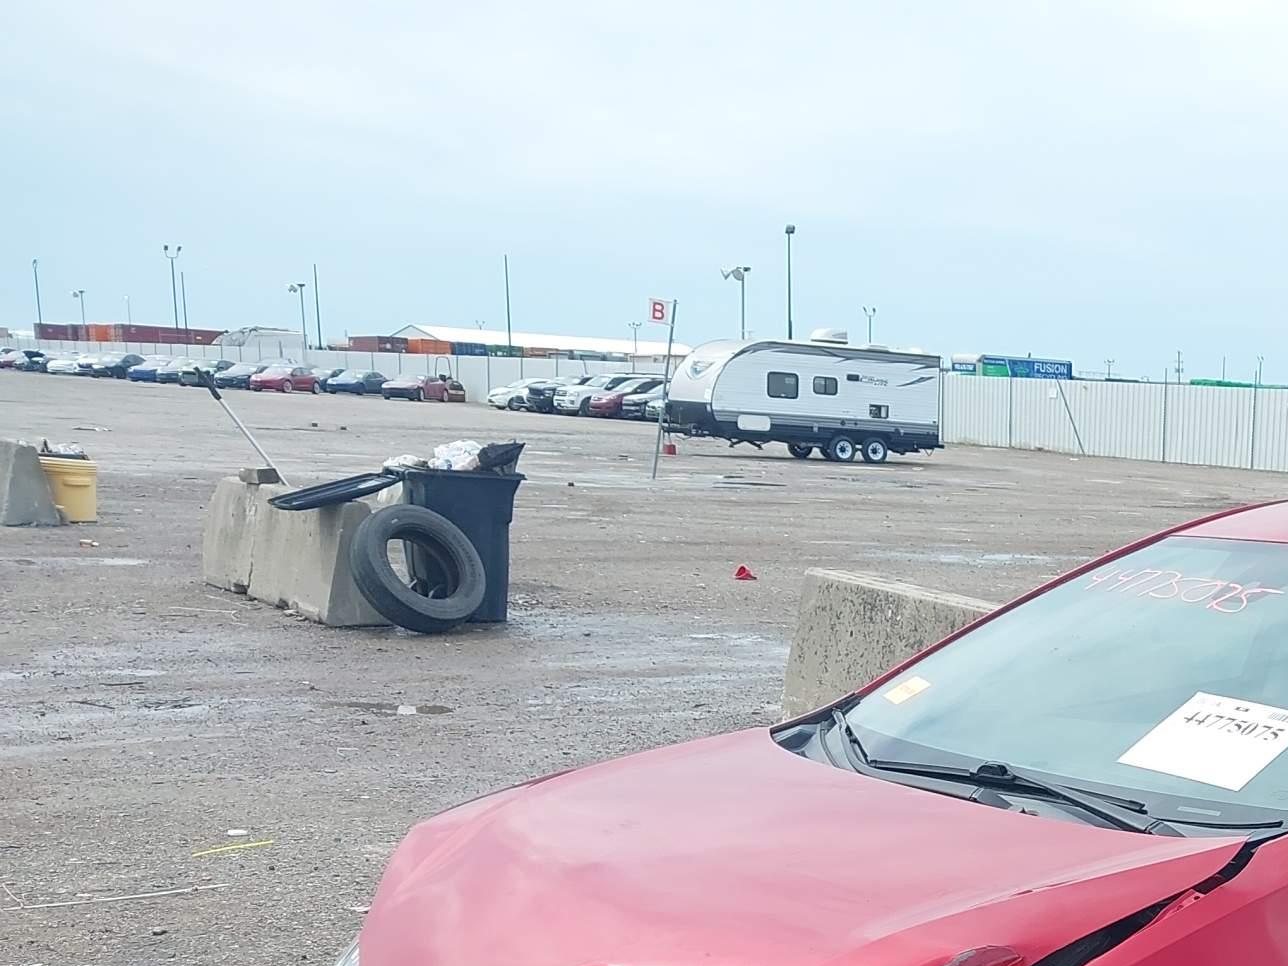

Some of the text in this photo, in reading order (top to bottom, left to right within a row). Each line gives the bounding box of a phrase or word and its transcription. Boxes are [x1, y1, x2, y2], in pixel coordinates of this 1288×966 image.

[652, 302, 665, 320] B
[1034, 362, 1068, 374] FUSION
[1083, 569, 1285, 614] 44775075
[1184, 711, 1286, 741] 44775075
